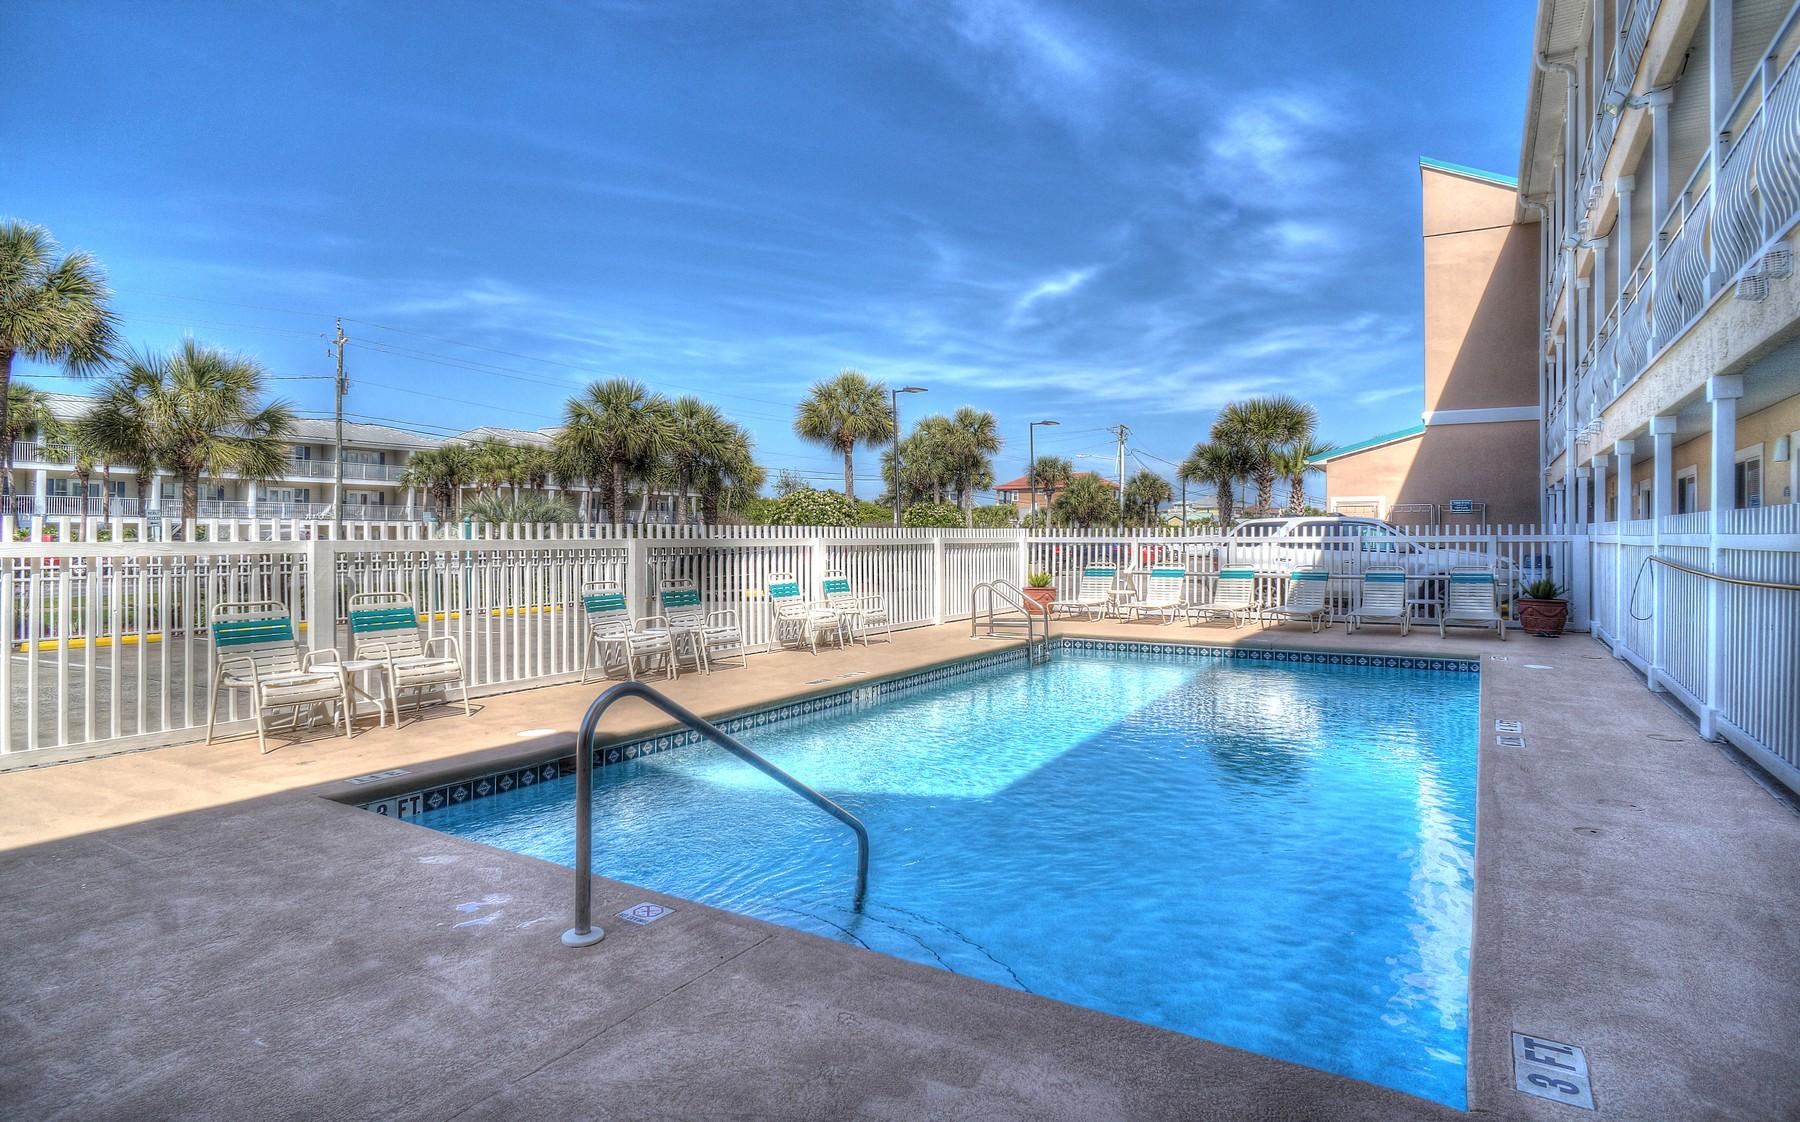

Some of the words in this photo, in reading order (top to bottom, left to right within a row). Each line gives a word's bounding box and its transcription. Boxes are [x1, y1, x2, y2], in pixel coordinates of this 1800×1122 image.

[398, 796, 420, 818] FT.
[1523, 1037, 1577, 1072] FT.
[1527, 1073, 1580, 1095] 3
